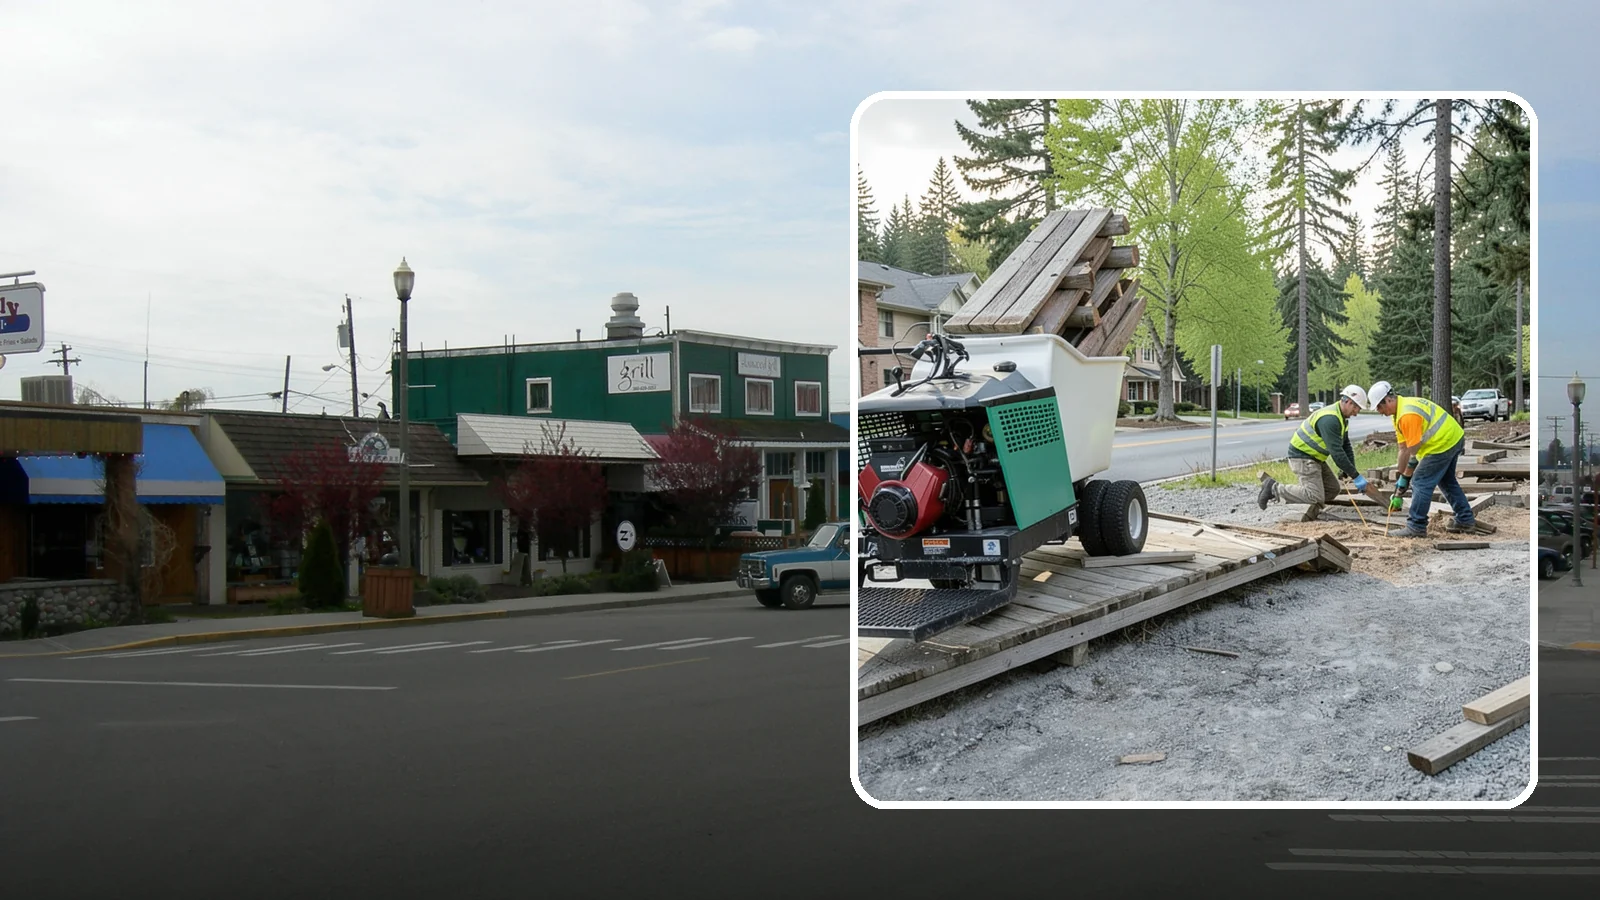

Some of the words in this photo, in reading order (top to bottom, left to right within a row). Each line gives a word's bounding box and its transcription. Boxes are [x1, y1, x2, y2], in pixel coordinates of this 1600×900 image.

[3, 338, 16, 346] Fries
[20, 336, 38, 345] Salads
[618, 356, 654, 391] grill
